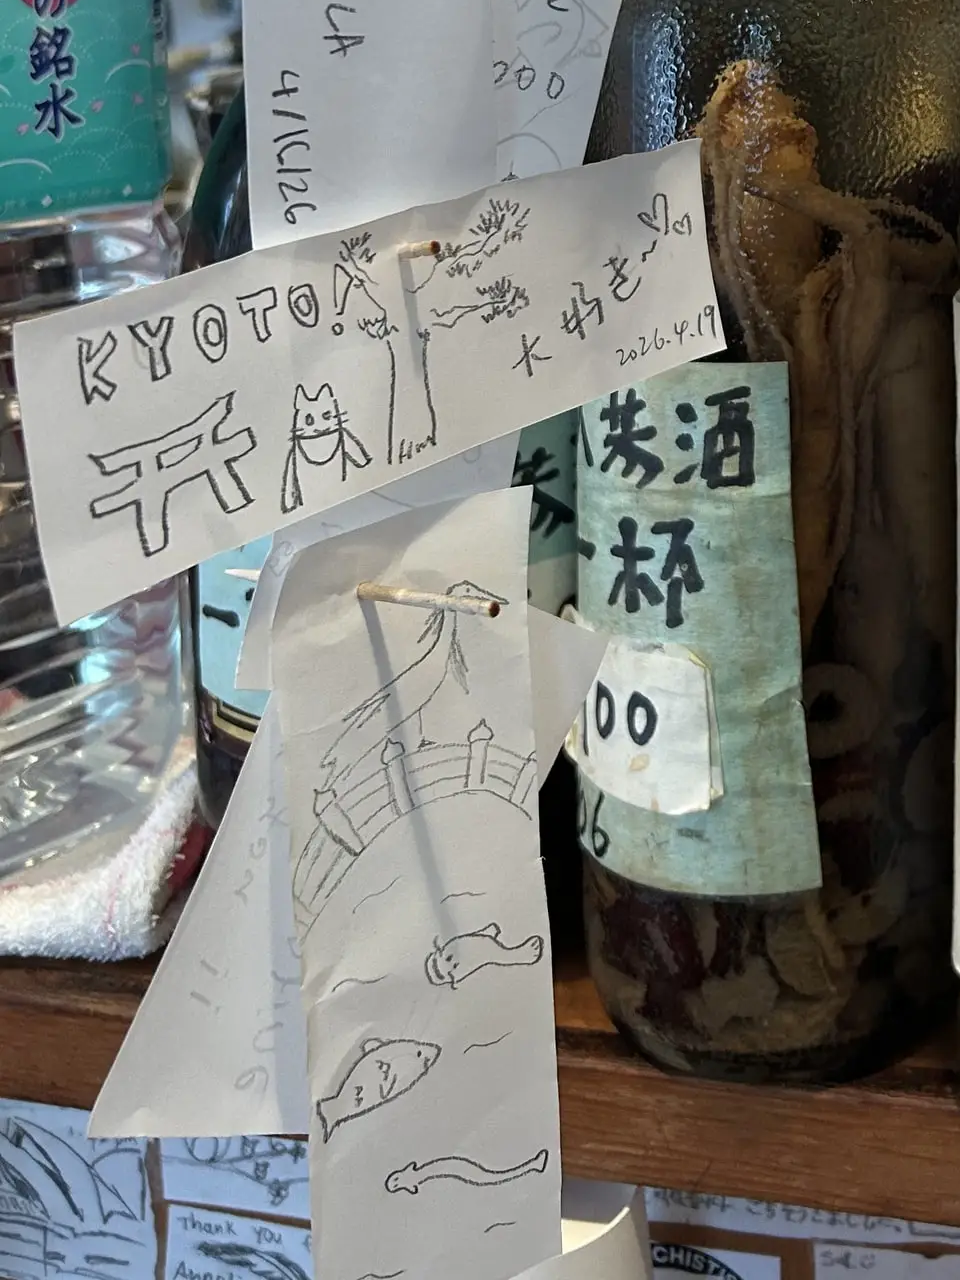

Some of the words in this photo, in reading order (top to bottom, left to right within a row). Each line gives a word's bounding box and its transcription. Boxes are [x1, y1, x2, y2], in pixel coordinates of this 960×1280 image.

[321, 2, 367, 58] LA
[77, 263, 351, 405] KYOTO!
[613, 304, 718, 369] 2026.4.19
[176, 1211, 239, 1237] Thank
